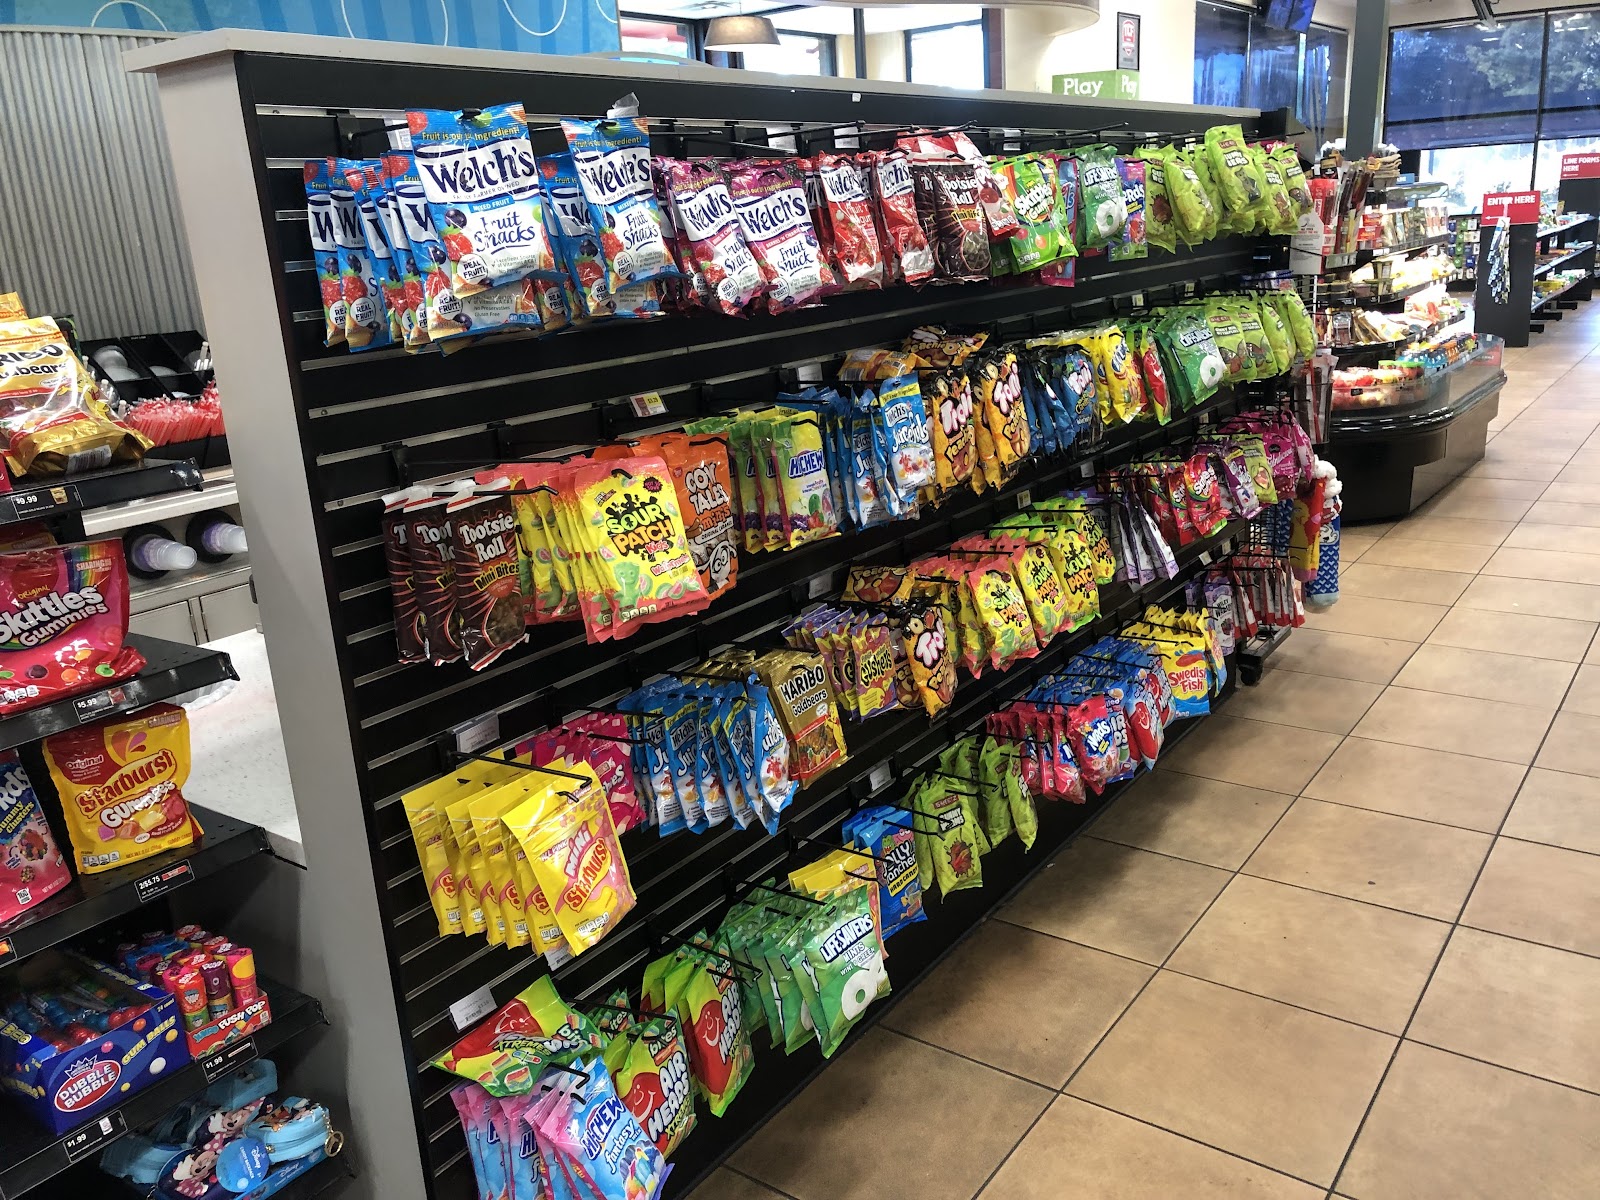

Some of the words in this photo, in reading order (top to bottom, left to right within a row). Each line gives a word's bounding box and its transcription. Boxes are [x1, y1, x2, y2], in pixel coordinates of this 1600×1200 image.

[1063, 78, 1103, 97] Play
[1121, 75, 1138, 99] Play
[422, 131, 440, 141] Fruit
[442, 132, 449, 140] is
[475, 126, 520, 141] Ingredient!
[421, 146, 535, 194] Welch's
[1563, 157, 1578, 165] LINE
[1578, 156, 1600, 164] FORMS
[581, 153, 650, 197] Welch's
[941, 174, 978, 190] Tootsie
[472, 203, 492, 212] MIXED
[492, 199, 511, 208] FRUIT
[952, 191, 972, 205] Roll
[1487, 196, 1513, 206] ENTER
[1514, 195, 1536, 204] HERE
[480, 211, 522, 233] Fruit
[739, 194, 807, 234] Welch's
[474, 226, 536, 252] Snacks
[779, 241, 805, 262] Fruit
[463, 260, 481, 270] REAL
[463, 267, 486, 279] FRUIT!
[721, 282, 734, 292] REAL
[355, 303, 371, 313] REAL
[355, 310, 375, 321] FRUIT!
[438, 303, 461, 314] FRUIT!
[940, 383, 974, 435] Trolli
[685, 462, 716, 493] COW
[16, 495, 38, 505] $9.99
[689, 483, 730, 515] TALES
[460, 513, 514, 545] Tootsie
[606, 503, 665, 534] SOUR
[702, 505, 731, 531] minis
[475, 535, 507, 563] Roll
[612, 518, 676, 555] PATCH
[645, 540, 670, 554] Kids
[475, 568, 495, 590] Mini
[495, 562, 520, 578] Bites
[1036, 575, 1057, 599] PATCH
[18, 585, 51, 599] ORIGINAL
[19, 604, 110, 647] Gummies
[860, 651, 893, 687] Gushers
[780, 664, 825, 703] HARIBO
[1180, 679, 1204, 693] Fish
[77, 698, 98, 708] $5.99
[792, 689, 828, 718] Goldbears
[671, 719, 696, 747] Welch's
[65, 755, 105, 769] Original
[78, 750, 172, 813] Starburst
[0, 800, 24, 834] ummy
[6, 801, 35, 834] Clusters
[890, 877, 904, 894] HARD
[902, 866, 919, 883] CANDY
[819, 913, 874, 964] LIFESAVERS
[839, 964, 854, 977] WINT
[218, 1011, 246, 1030] PUSH
[245, 1000, 266, 1016] POP
[721, 982, 740, 1023] AIR
[122, 1038, 148, 1065] GUM
[146, 1014, 177, 1044] BALLS
[649, 1025, 677, 1056] bites
[205, 1056, 223, 1069] $1.99
[659, 1050, 687, 1098] AIR
[58, 1063, 113, 1100] DUBBLE
[63, 1070, 118, 1109] BUBBLE
[647, 1079, 690, 1143] HEADS
[66, 1133, 87, 1148] $1.99
[604, 1119, 636, 1176] fantasy
[251, 1145, 262, 1169] Disney
[280, 1162, 300, 1178] Disney
